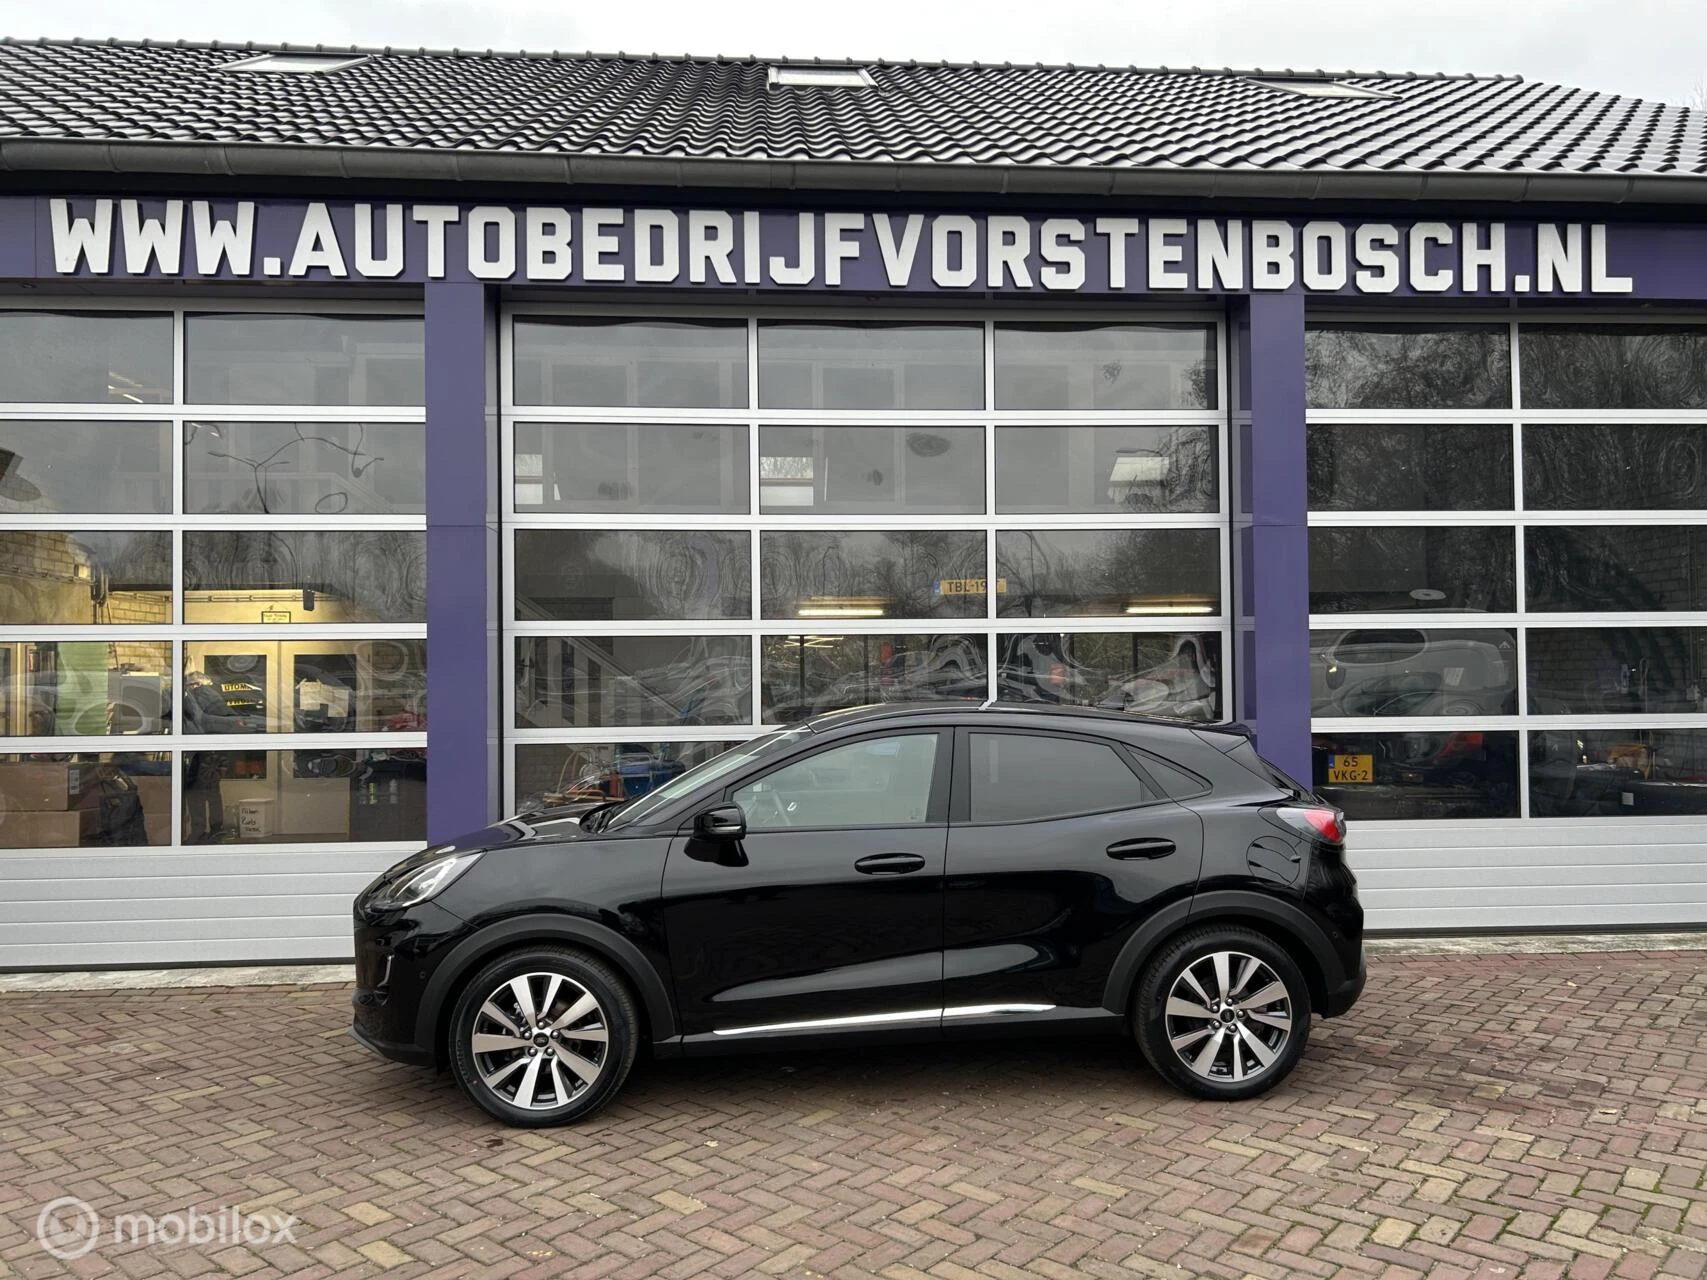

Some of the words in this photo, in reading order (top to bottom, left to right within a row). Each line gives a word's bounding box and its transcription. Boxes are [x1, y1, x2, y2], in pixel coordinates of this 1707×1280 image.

[50, 199, 1633, 294] WWW.AUTOBEDRIJFVORSTENBOSCH.NL
[947, 581, 1000, 594] TBL-19
[1343, 756, 1358, 768] 65
[1333, 770, 1368, 781] VKG-2
